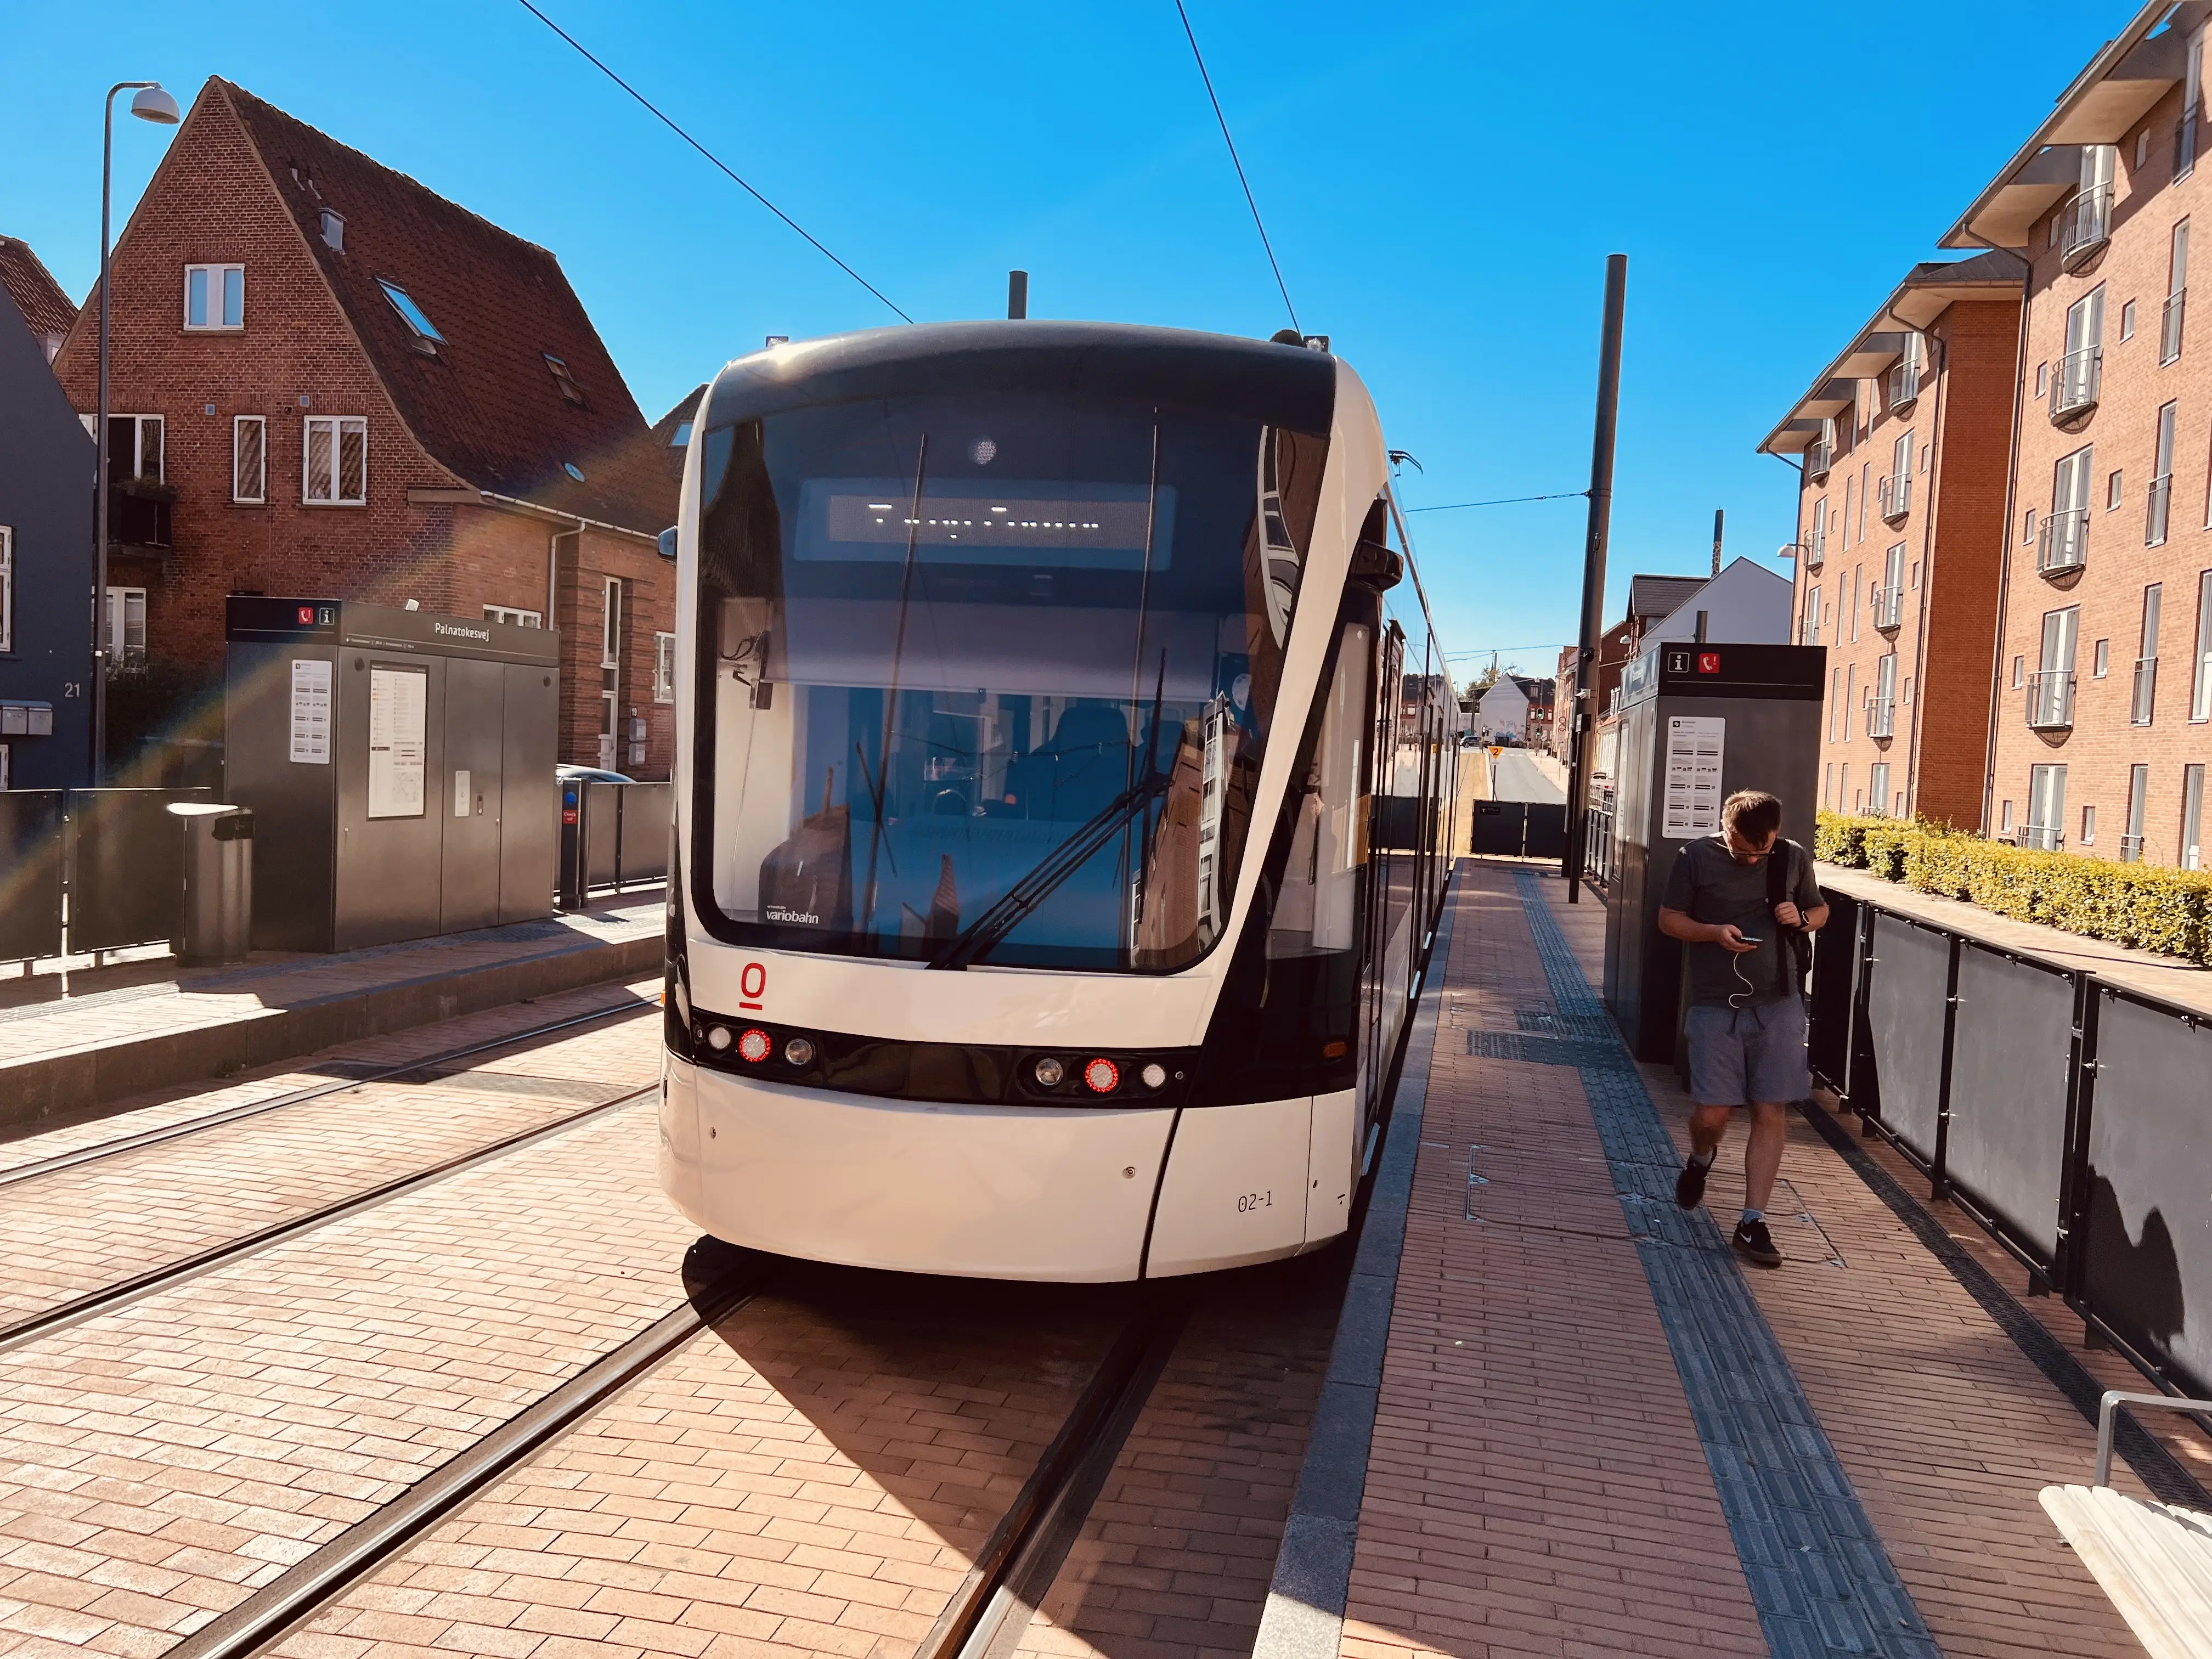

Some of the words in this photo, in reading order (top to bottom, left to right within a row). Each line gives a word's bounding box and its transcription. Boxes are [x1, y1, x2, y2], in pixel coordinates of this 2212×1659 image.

[435, 622, 490, 642] Palnatokesvej
[64, 682, 81, 698] 21
[1493, 748, 1499, 756] 2
[766, 910, 819, 924] variobahn
[1238, 1190, 1273, 1212] 02-1
